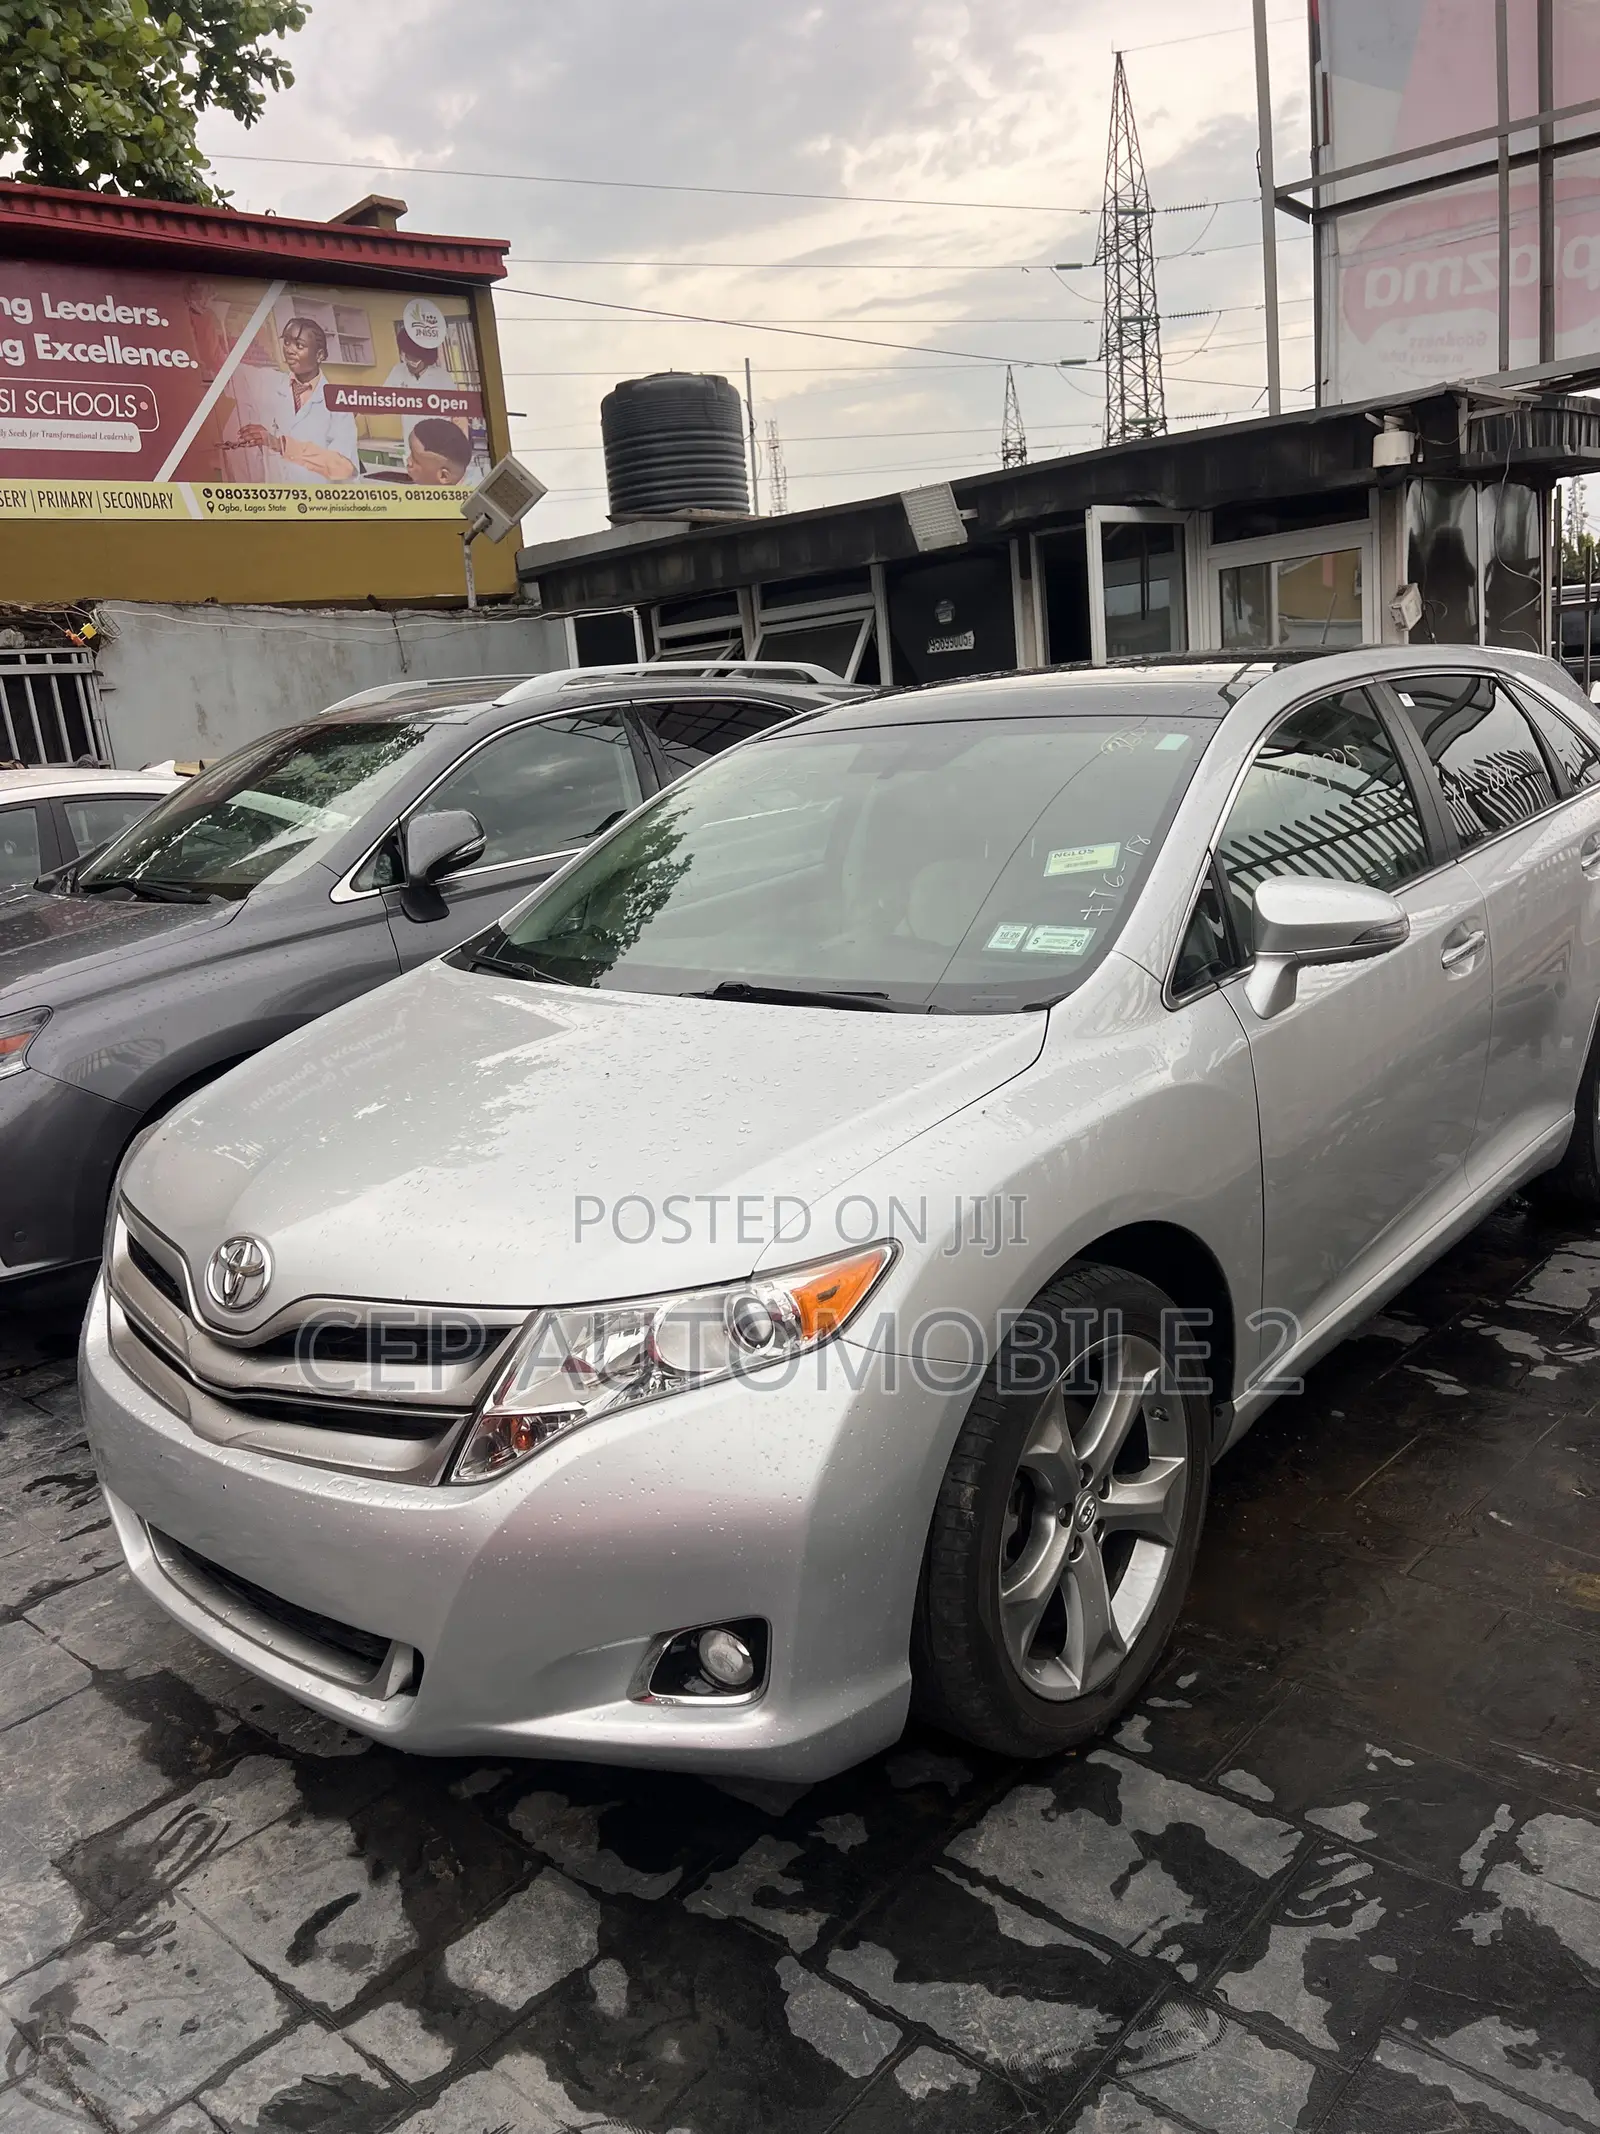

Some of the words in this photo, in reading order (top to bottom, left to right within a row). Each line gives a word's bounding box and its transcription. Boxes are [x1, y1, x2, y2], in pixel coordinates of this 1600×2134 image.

[41, 292, 169, 327] Leaders.
[0, 338, 25, 367] g
[33, 333, 199, 369] Excellence.
[25, 389, 137, 418] SCHOOLS
[335, 389, 423, 409] Admissions
[427, 394, 468, 413] Open
[28, 429, 39, 440] for
[42, 430, 98, 441] Transformational
[100, 432, 134, 443] Leadership
[38, 490, 93, 508] PRIMARY
[103, 491, 173, 509] SECONDARY
[215, 488, 312, 502] 08033037793,
[315, 489, 402, 502] 08022016105,
[405, 490, 473, 501] 081206388
[218, 503, 242, 513] Ogba,
[244, 503, 267, 513] Lagos
[268, 503, 286, 512] State
[309, 502, 388, 514] www.jnissischools.com
